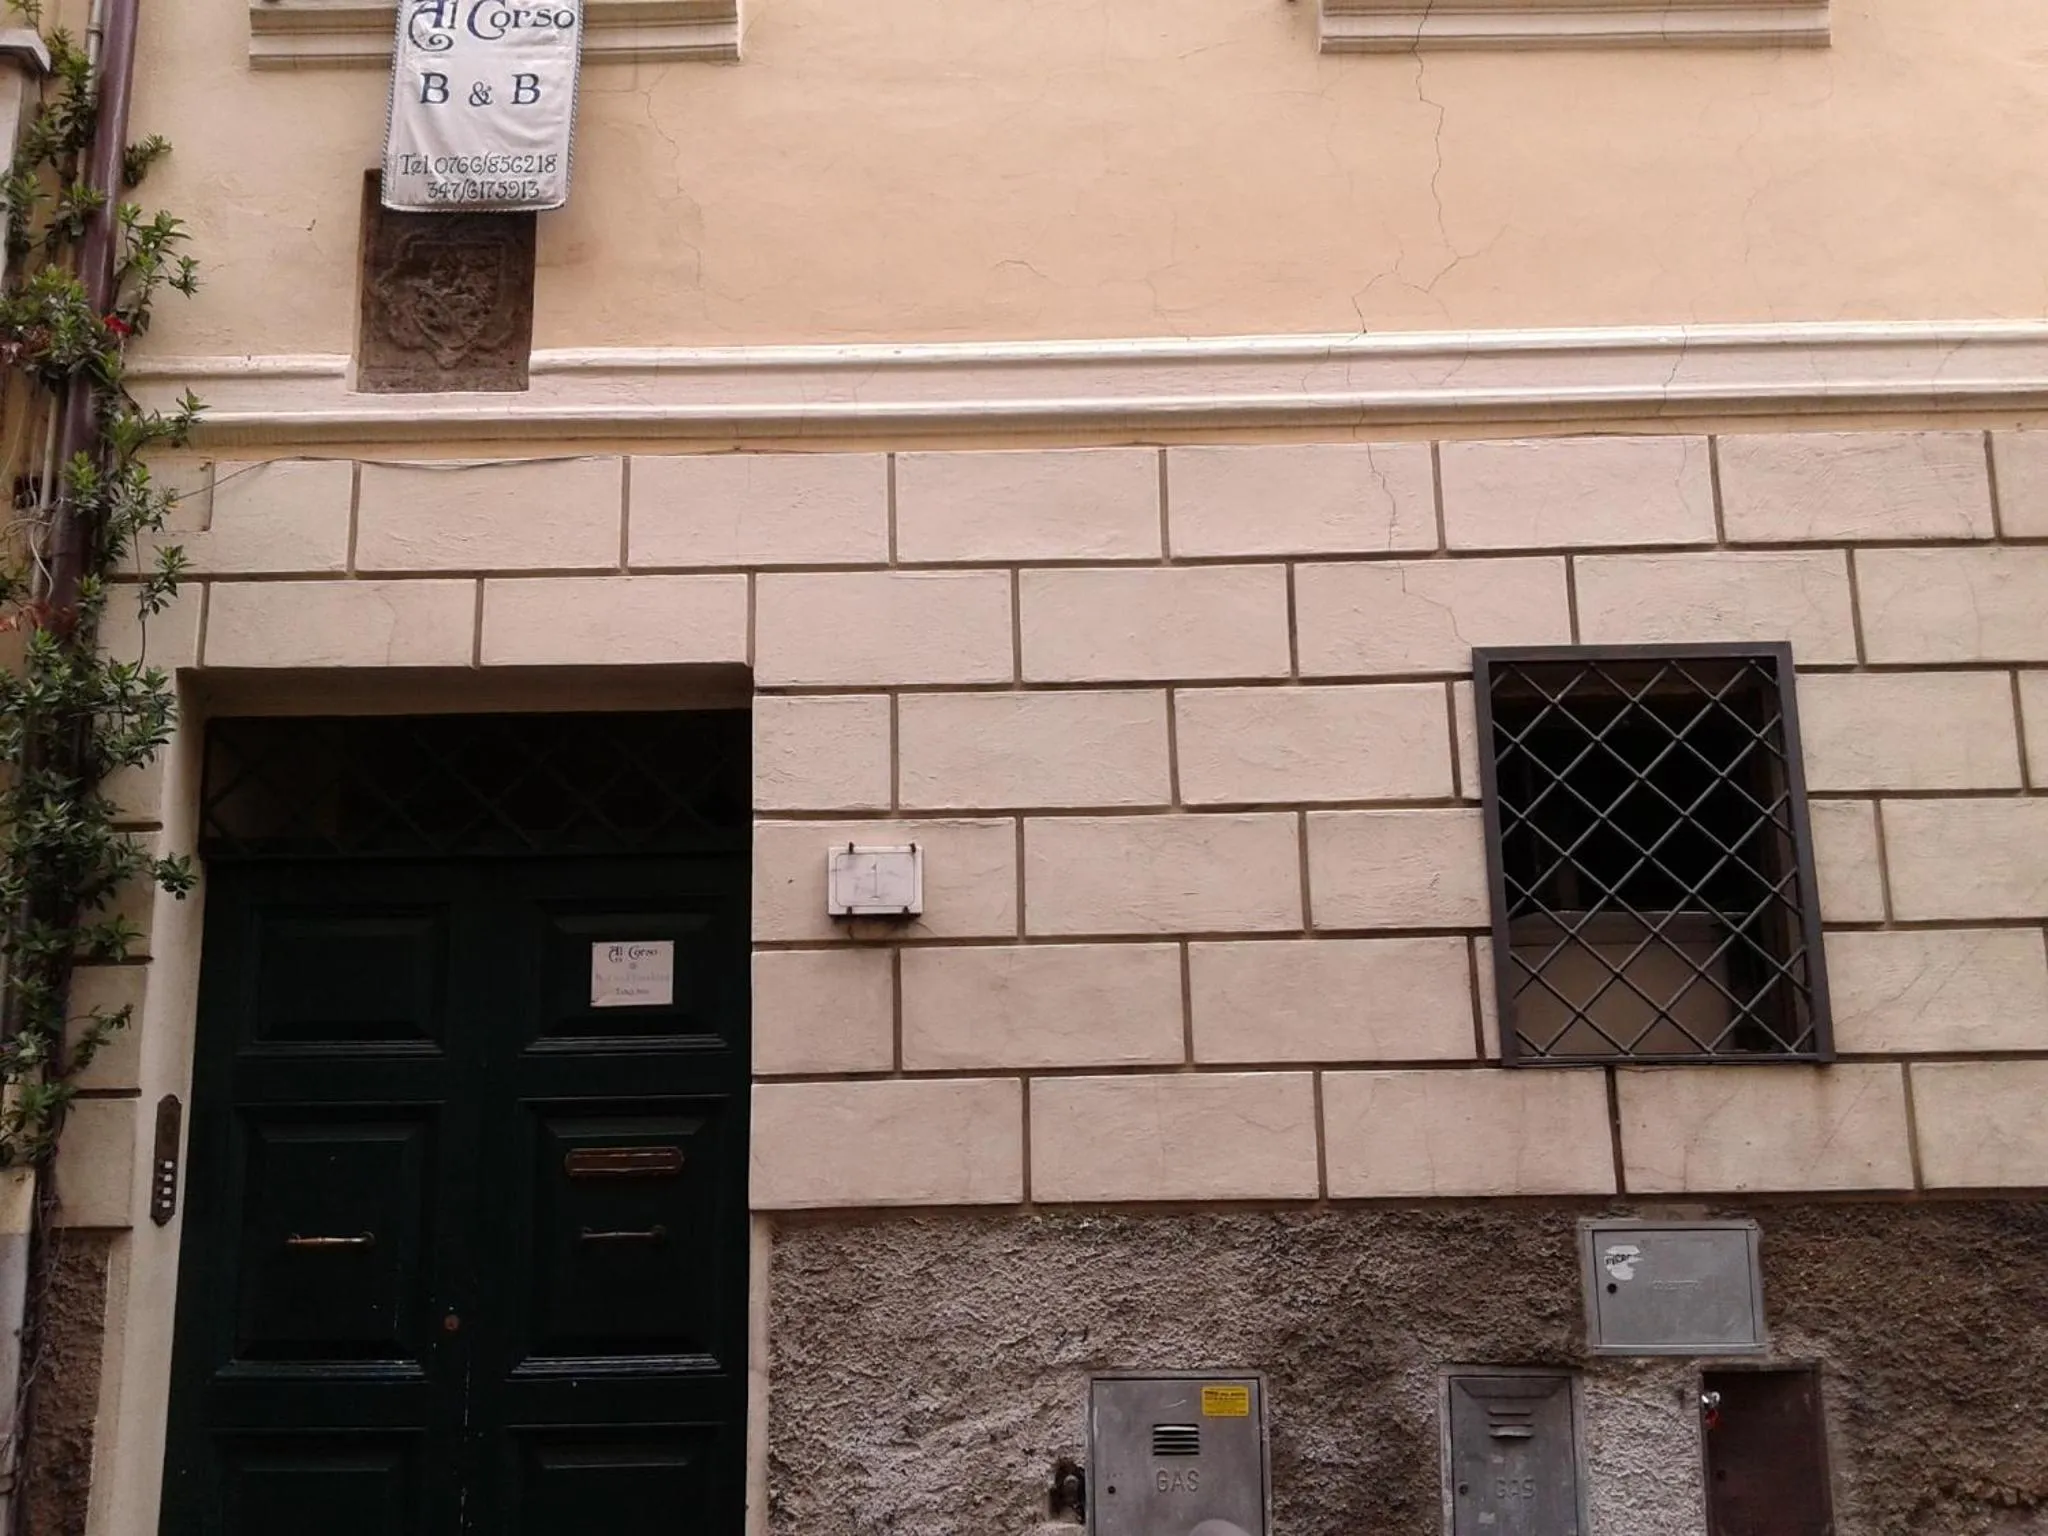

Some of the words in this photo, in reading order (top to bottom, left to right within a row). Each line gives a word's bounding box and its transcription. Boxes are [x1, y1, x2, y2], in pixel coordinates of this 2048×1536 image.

[408, 0, 457, 51] Al
[466, 0, 575, 40] Corso
[420, 72, 450, 105] B
[469, 81, 494, 107] &
[511, 73, 541, 105] B
[1155, 1469, 1200, 1493] GAS
